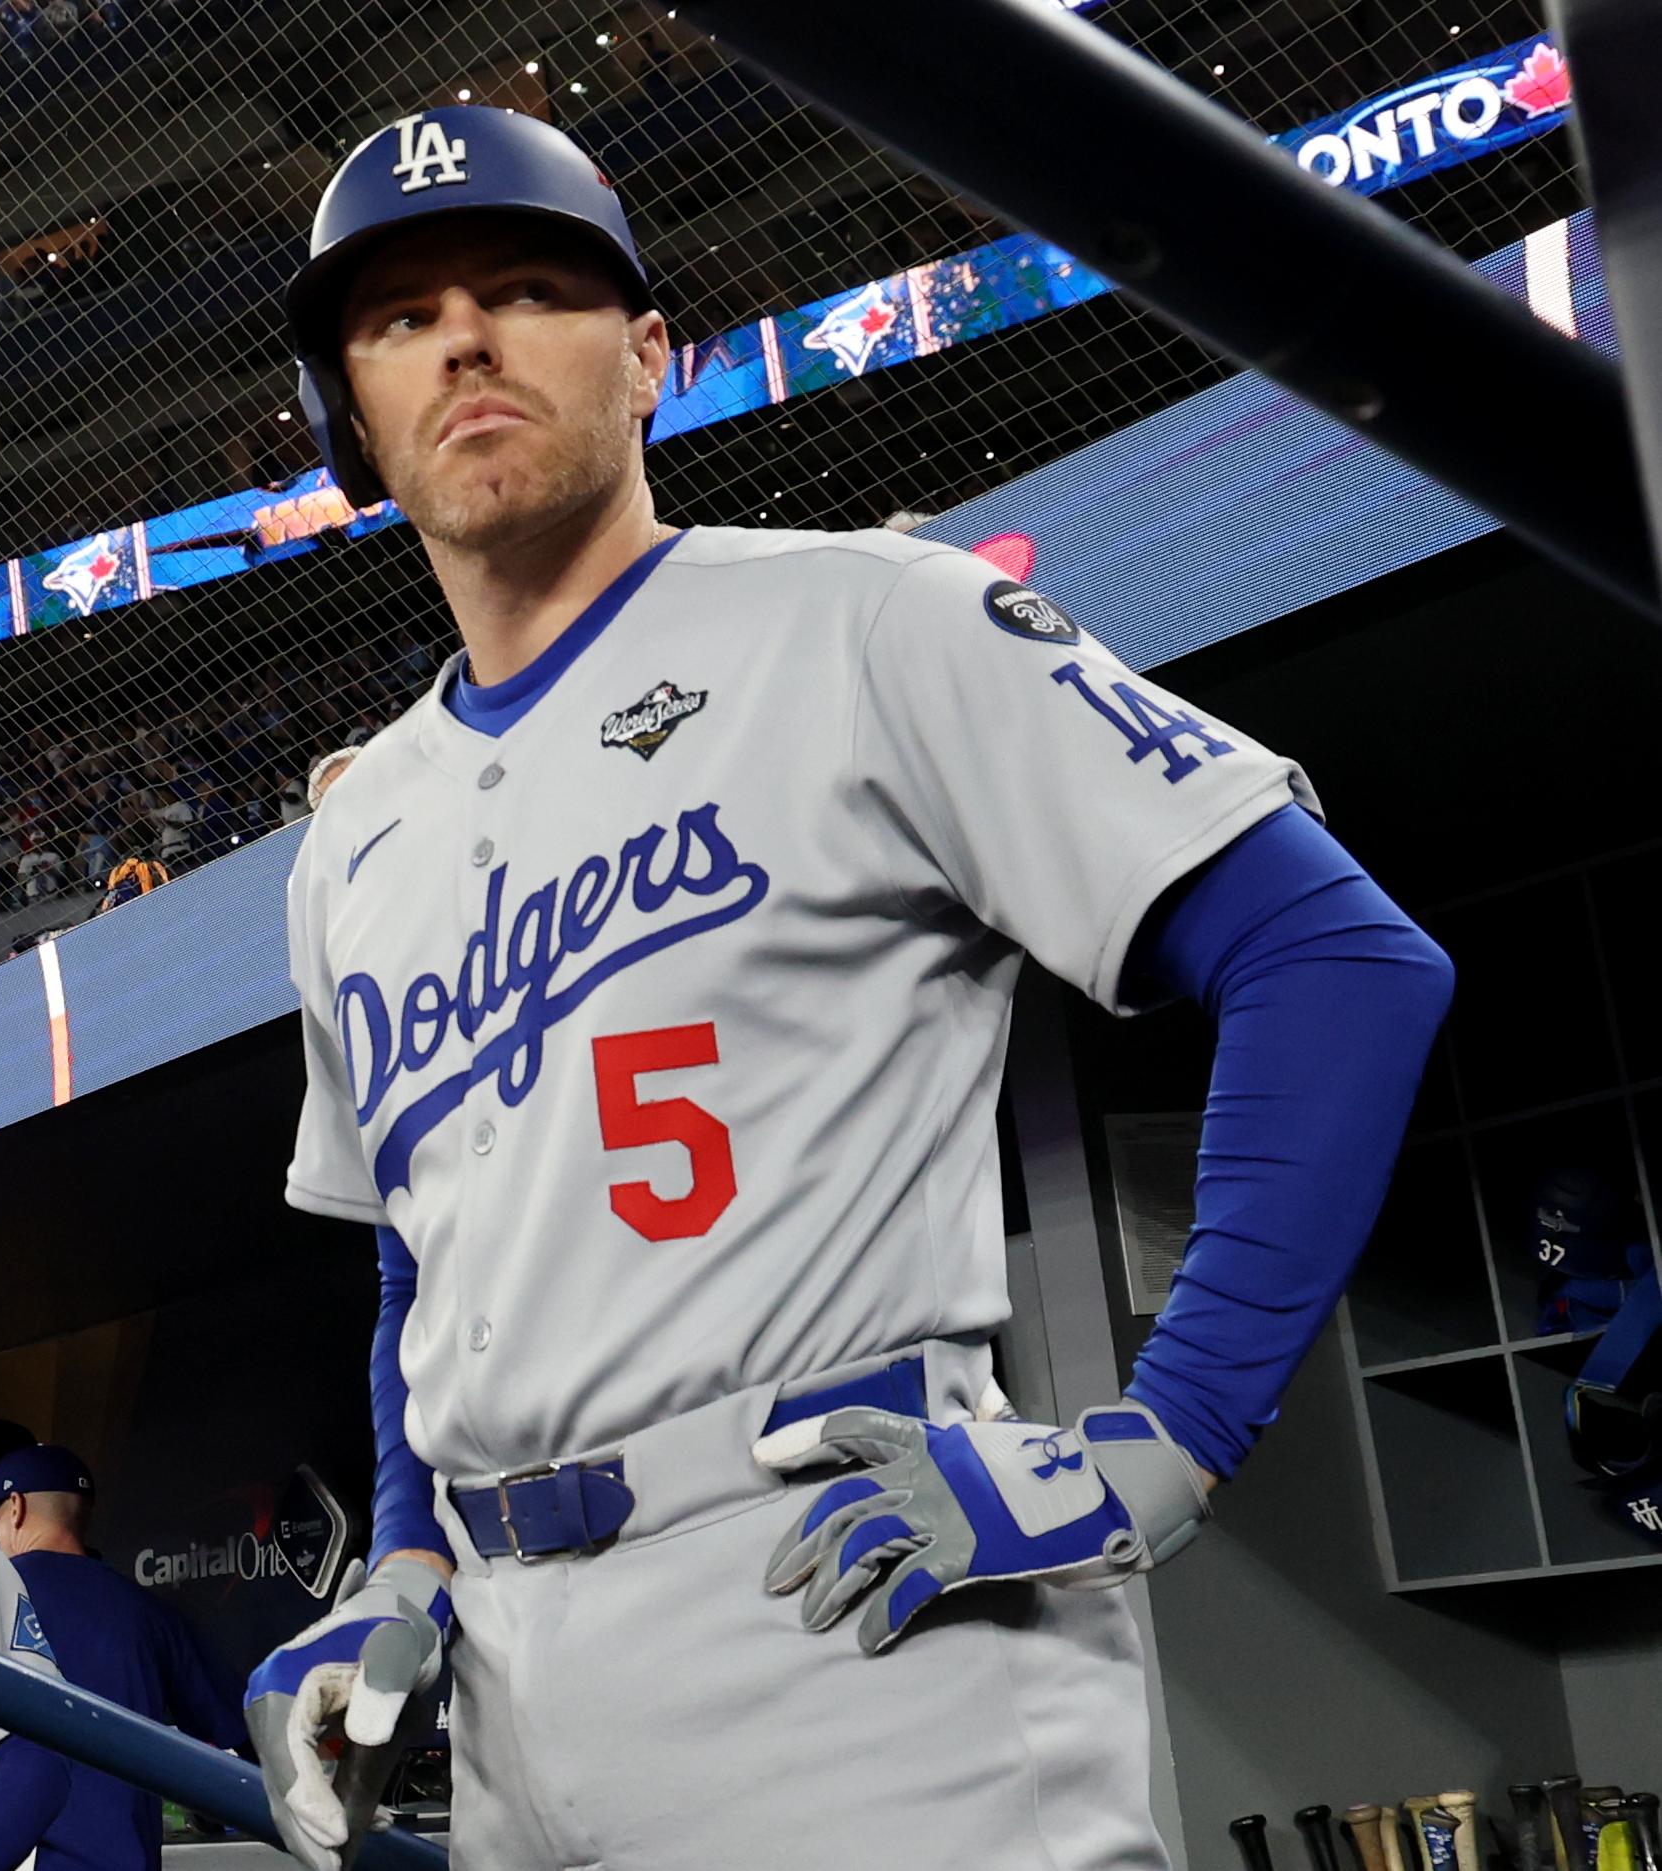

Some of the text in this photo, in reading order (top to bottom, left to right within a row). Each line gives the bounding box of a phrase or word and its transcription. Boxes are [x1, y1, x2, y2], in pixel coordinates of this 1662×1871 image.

[393, 113, 467, 193] LA
[1298, 77, 1502, 187] ONTO
[1050, 661, 1237, 785] LA
[334, 802, 763, 1140] Dodgers
[591, 1021, 738, 1243] 5
[1538, 1238, 1566, 1267] 37
